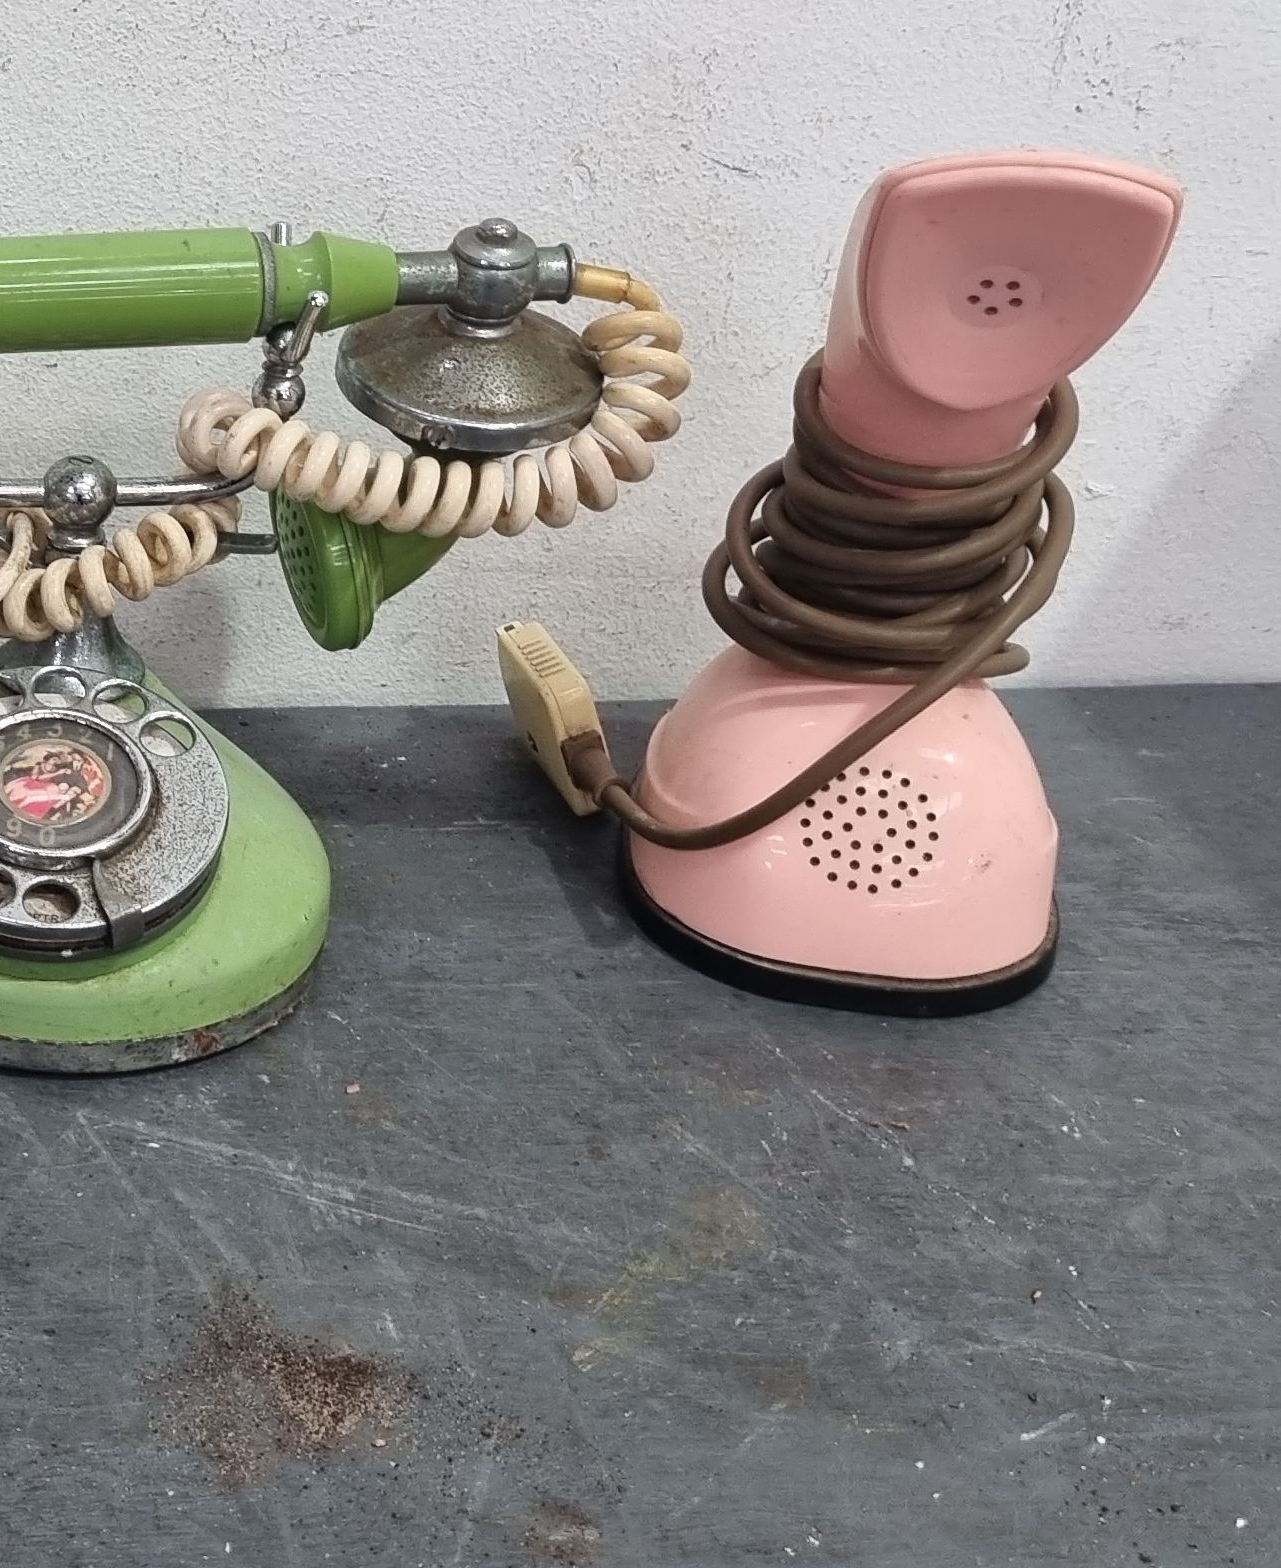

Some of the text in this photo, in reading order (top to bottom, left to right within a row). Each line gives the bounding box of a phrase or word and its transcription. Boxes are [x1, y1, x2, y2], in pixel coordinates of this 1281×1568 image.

[17, 724, 31, 740] 4
[6, 818, 22, 837] 9
[39, 828, 56, 846] 0
